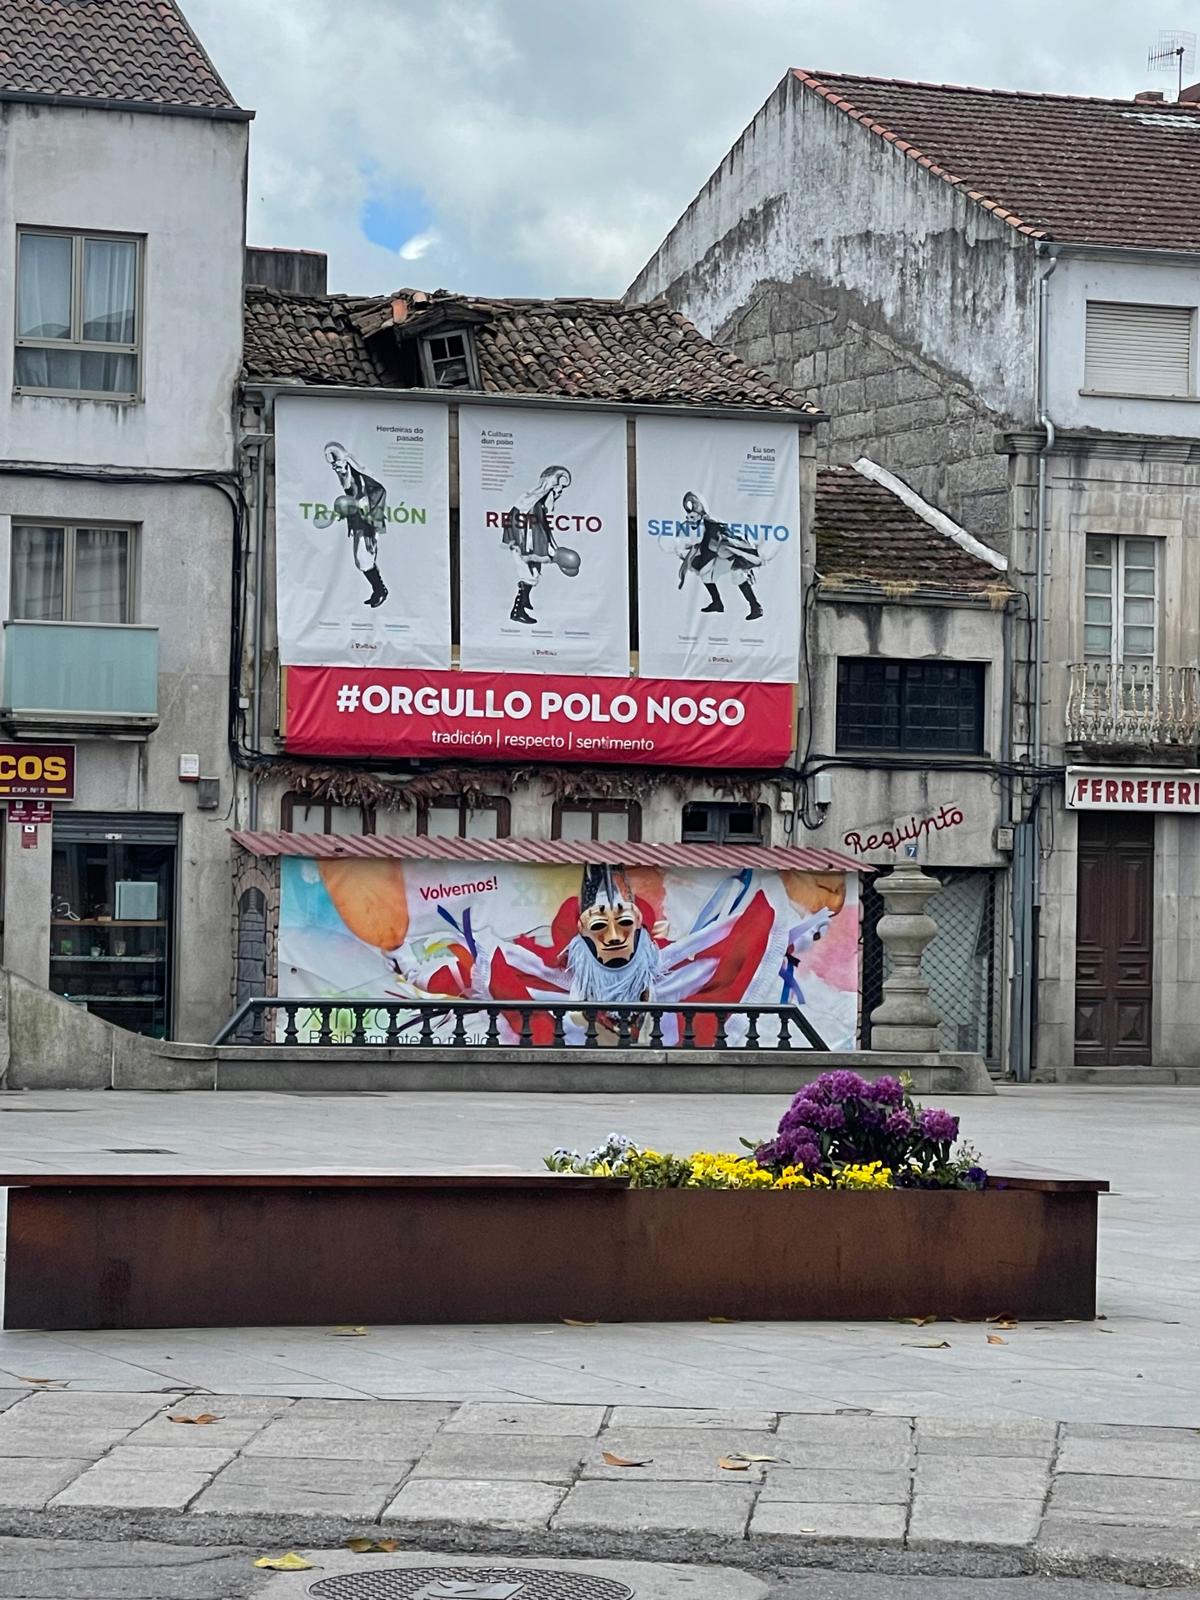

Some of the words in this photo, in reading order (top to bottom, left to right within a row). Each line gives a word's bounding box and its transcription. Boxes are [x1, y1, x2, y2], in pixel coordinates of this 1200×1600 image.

[486, 511, 602, 532] RESPECTO
[648, 519, 789, 541] SENTENTO
[336, 685, 532, 720] #ORGULLO
[541, 691, 638, 724] POLO
[647, 695, 745, 727] NOSO
[431, 729, 492, 745] tradición
[504, 733, 564, 749] respecto
[576, 735, 654, 751] sentimento
[0, 755, 67, 781] COS
[1077, 778, 1200, 805] FERRETERI
[844, 806, 963, 854] Requinto
[909, 847, 915, 857] 7
[419, 875, 498, 901] Volvemos!
